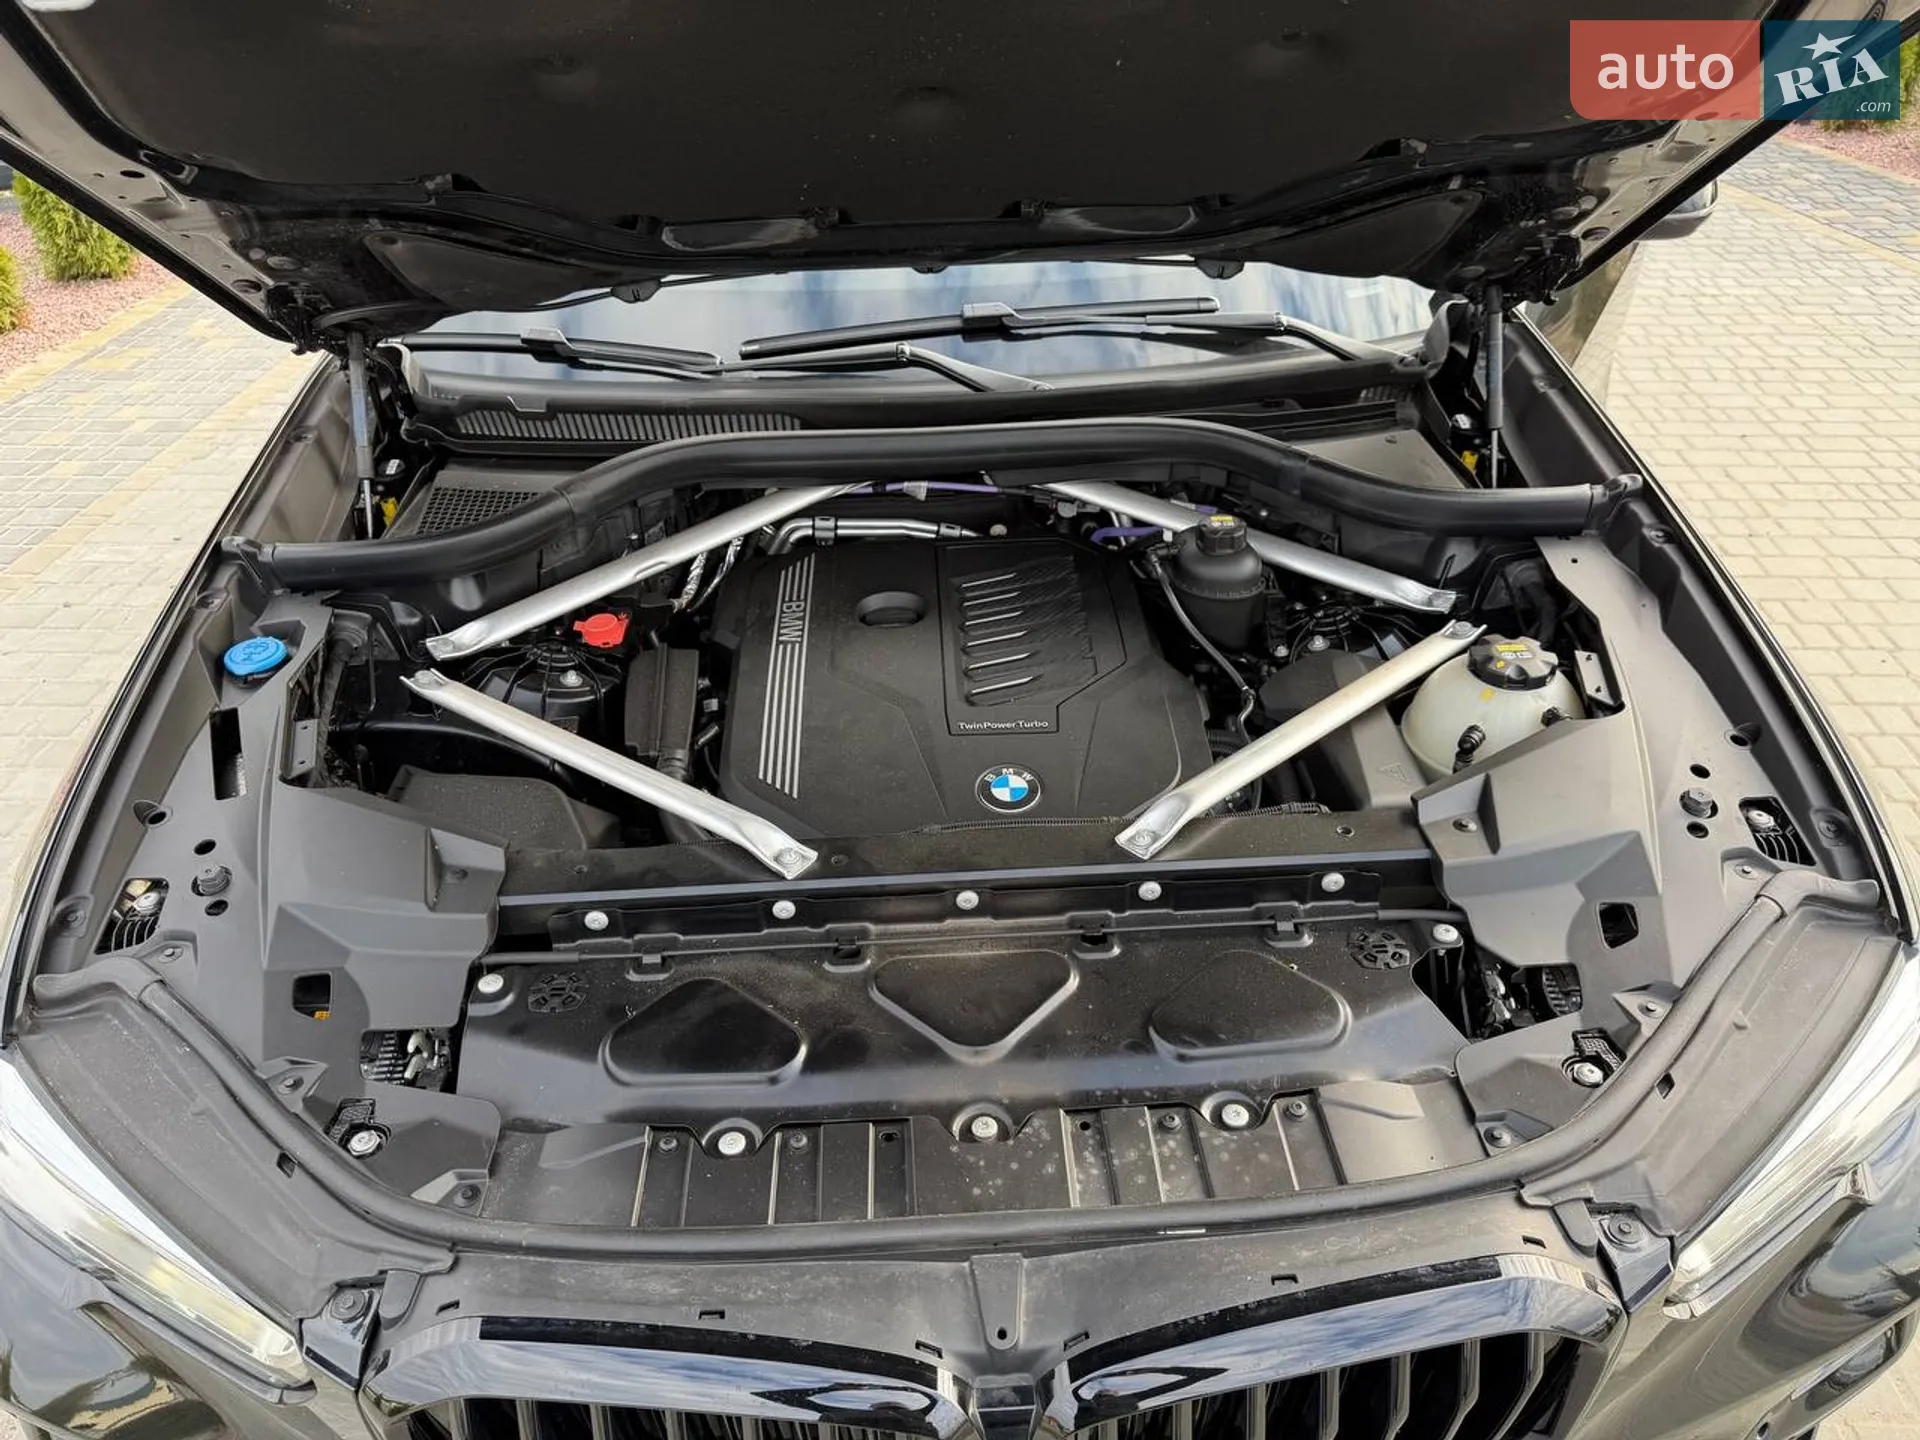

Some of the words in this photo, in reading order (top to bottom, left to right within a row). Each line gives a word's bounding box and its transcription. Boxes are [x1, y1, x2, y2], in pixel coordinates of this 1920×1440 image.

[779, 601, 805, 641] BMW
[959, 721, 1016, 730] TwinPower
[1019, 720, 1049, 729] Turbo
[984, 768, 1034, 782] BMW
